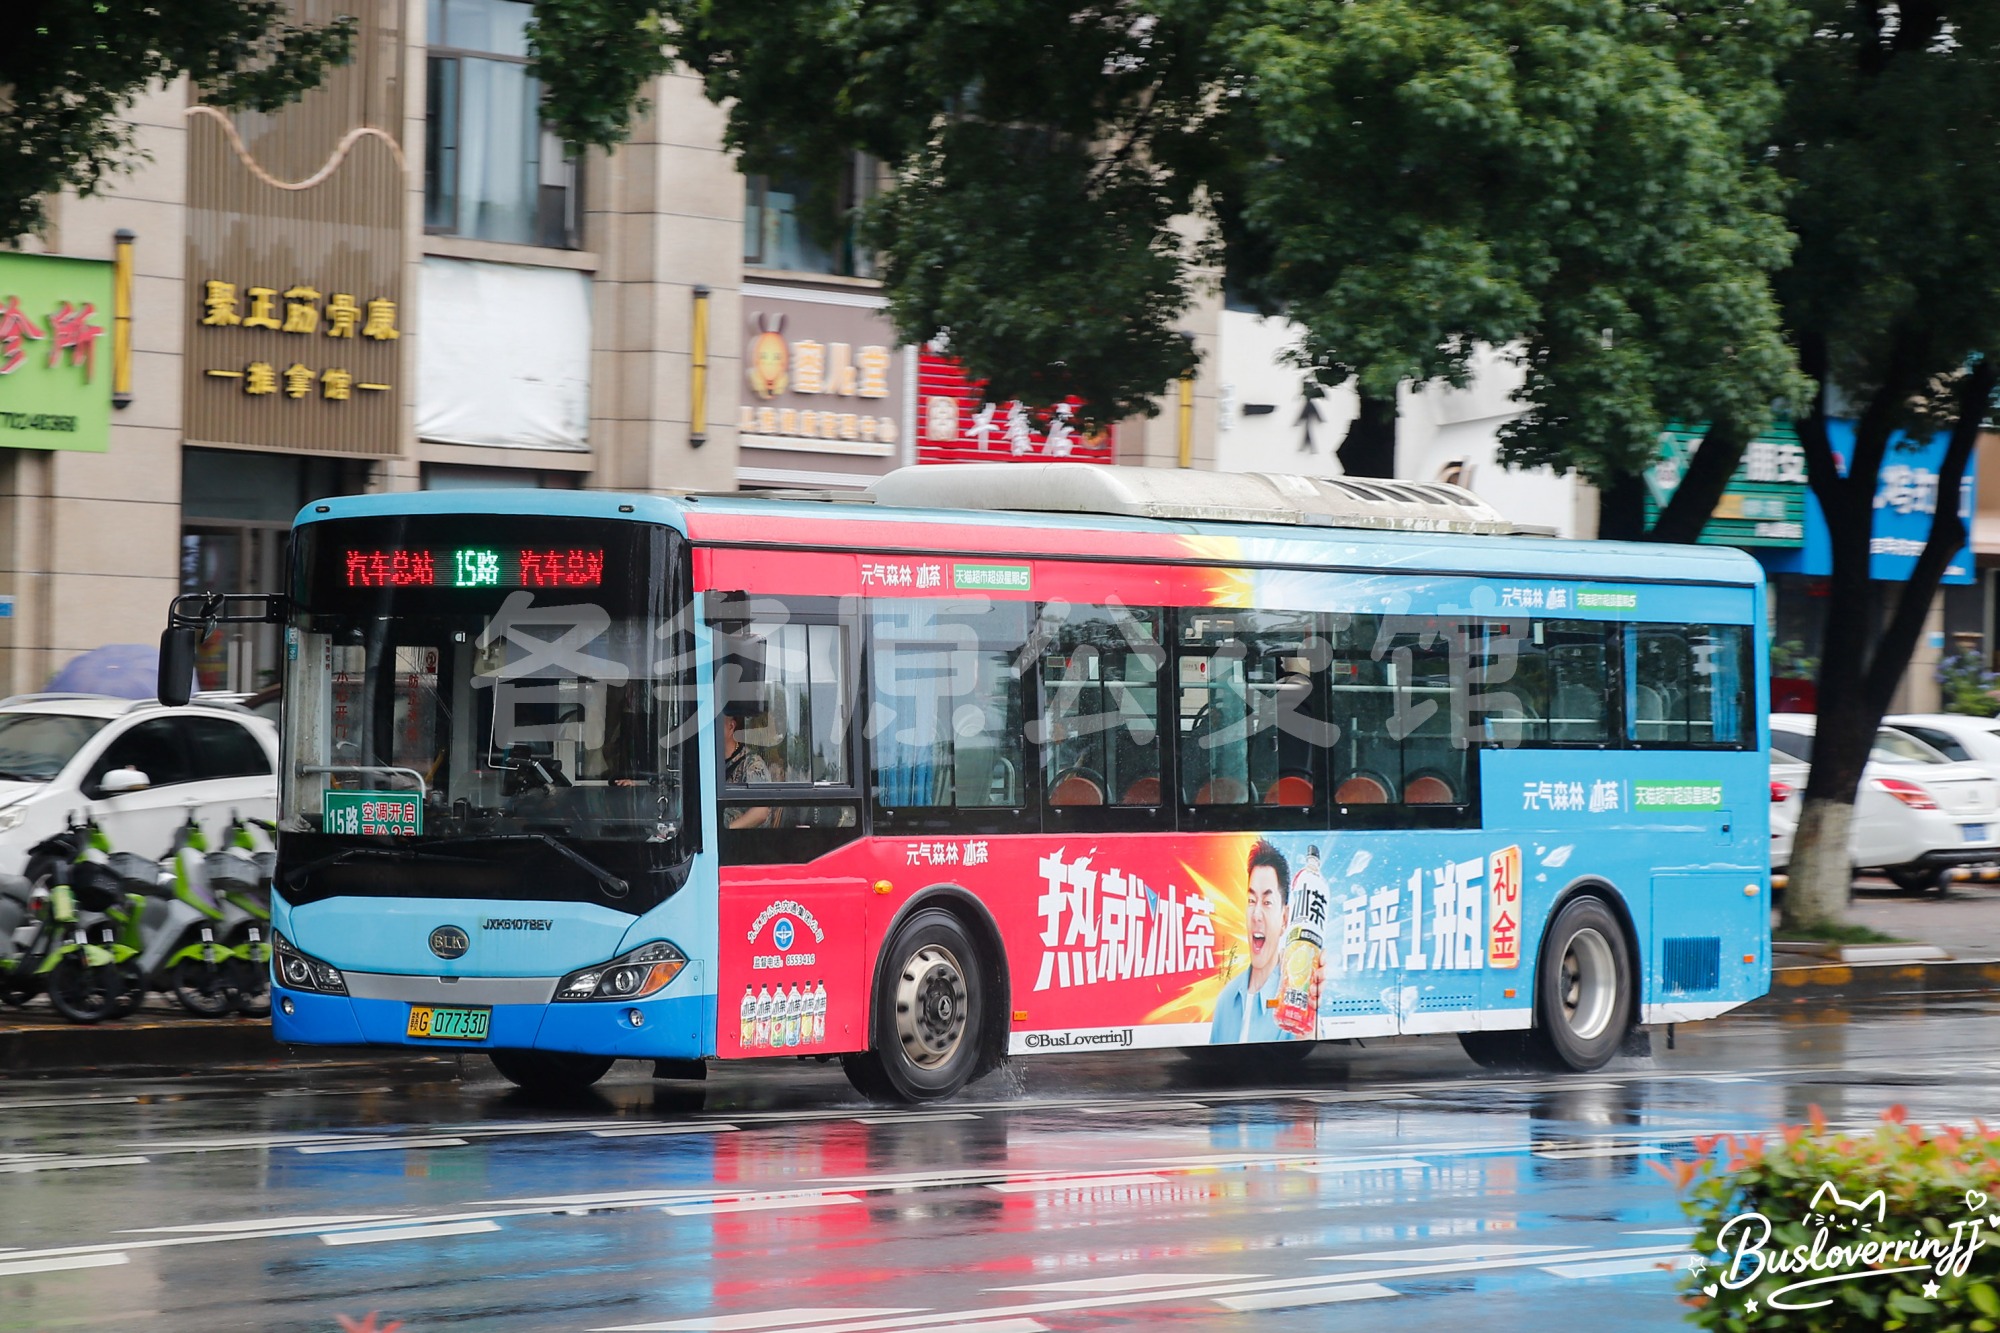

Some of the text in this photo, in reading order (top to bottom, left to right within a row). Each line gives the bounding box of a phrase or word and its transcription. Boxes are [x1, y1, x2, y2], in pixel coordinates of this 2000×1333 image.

[347, 550, 434, 586] 汽车总站
[456, 550, 500, 587] 15路
[861, 563, 941, 588] 元气森林 冰茶
[1502, 587, 1544, 608] 元气森林
[1523, 779, 1618, 812] 元气森林 冰茶
[330, 805, 358, 834] 15路
[362, 801, 416, 822] 空调开启
[907, 840, 988, 866] 元气森林 冰茶
[1033, 845, 1215, 991] 热就冰茶
[1342, 856, 1484, 971] 再来1瓶
[1493, 856, 1517, 959] 礼金
[786, 954, 815, 966] 8553416
